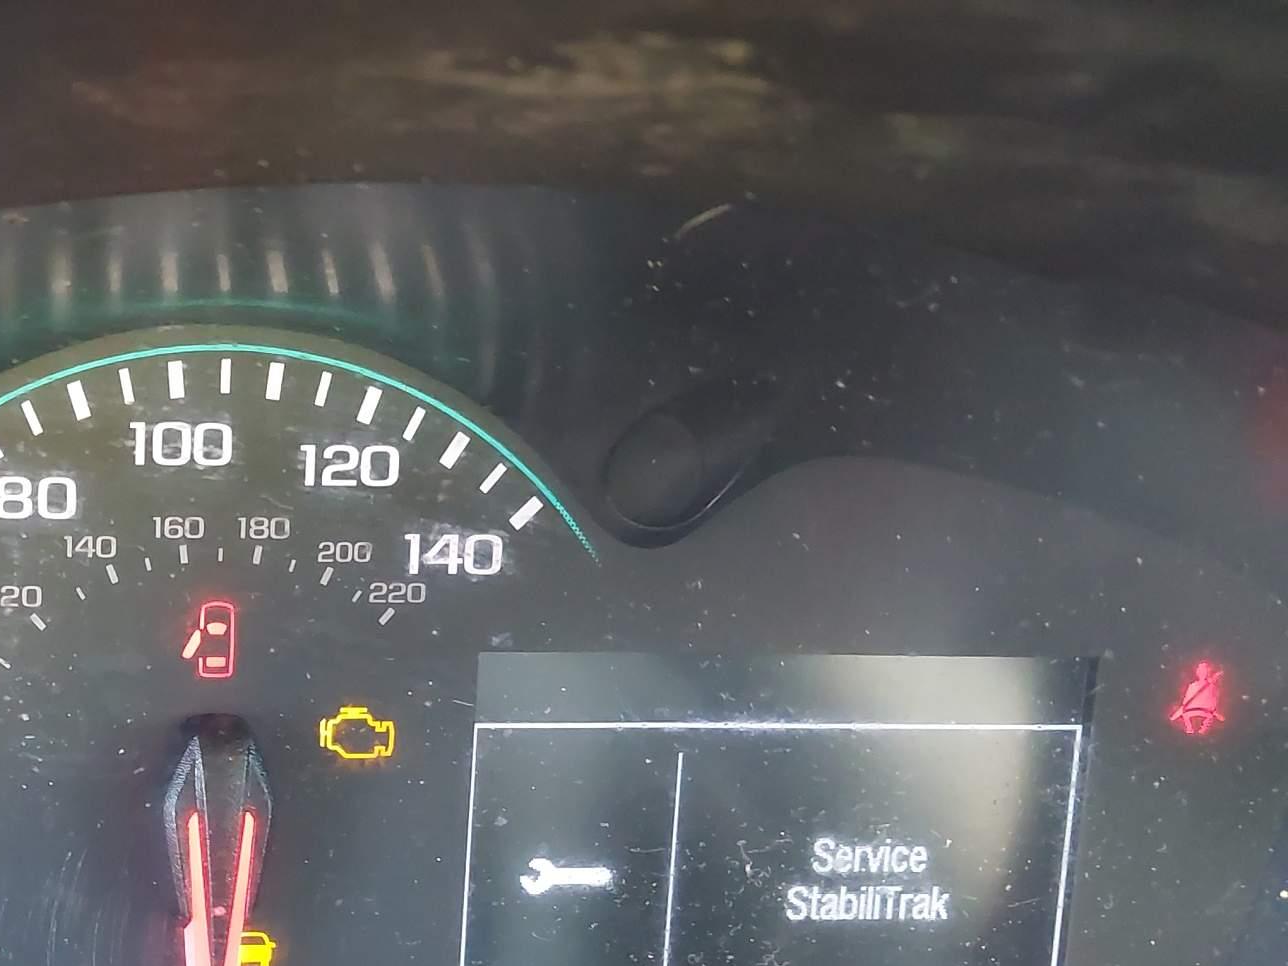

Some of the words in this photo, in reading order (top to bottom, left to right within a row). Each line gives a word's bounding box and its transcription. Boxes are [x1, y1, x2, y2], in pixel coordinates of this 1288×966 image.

[128, 421, 233, 467] 100
[300, 444, 400, 488] 120
[152, 517, 205, 540] 160
[237, 517, 290, 540] 180
[64, 535, 117, 560] 140
[317, 542, 371, 564] 200
[406, 533, 503, 576] 140
[368, 582, 426, 605] 220
[811, 838, 928, 876] Service
[785, 885, 950, 923] StabiliTrak
